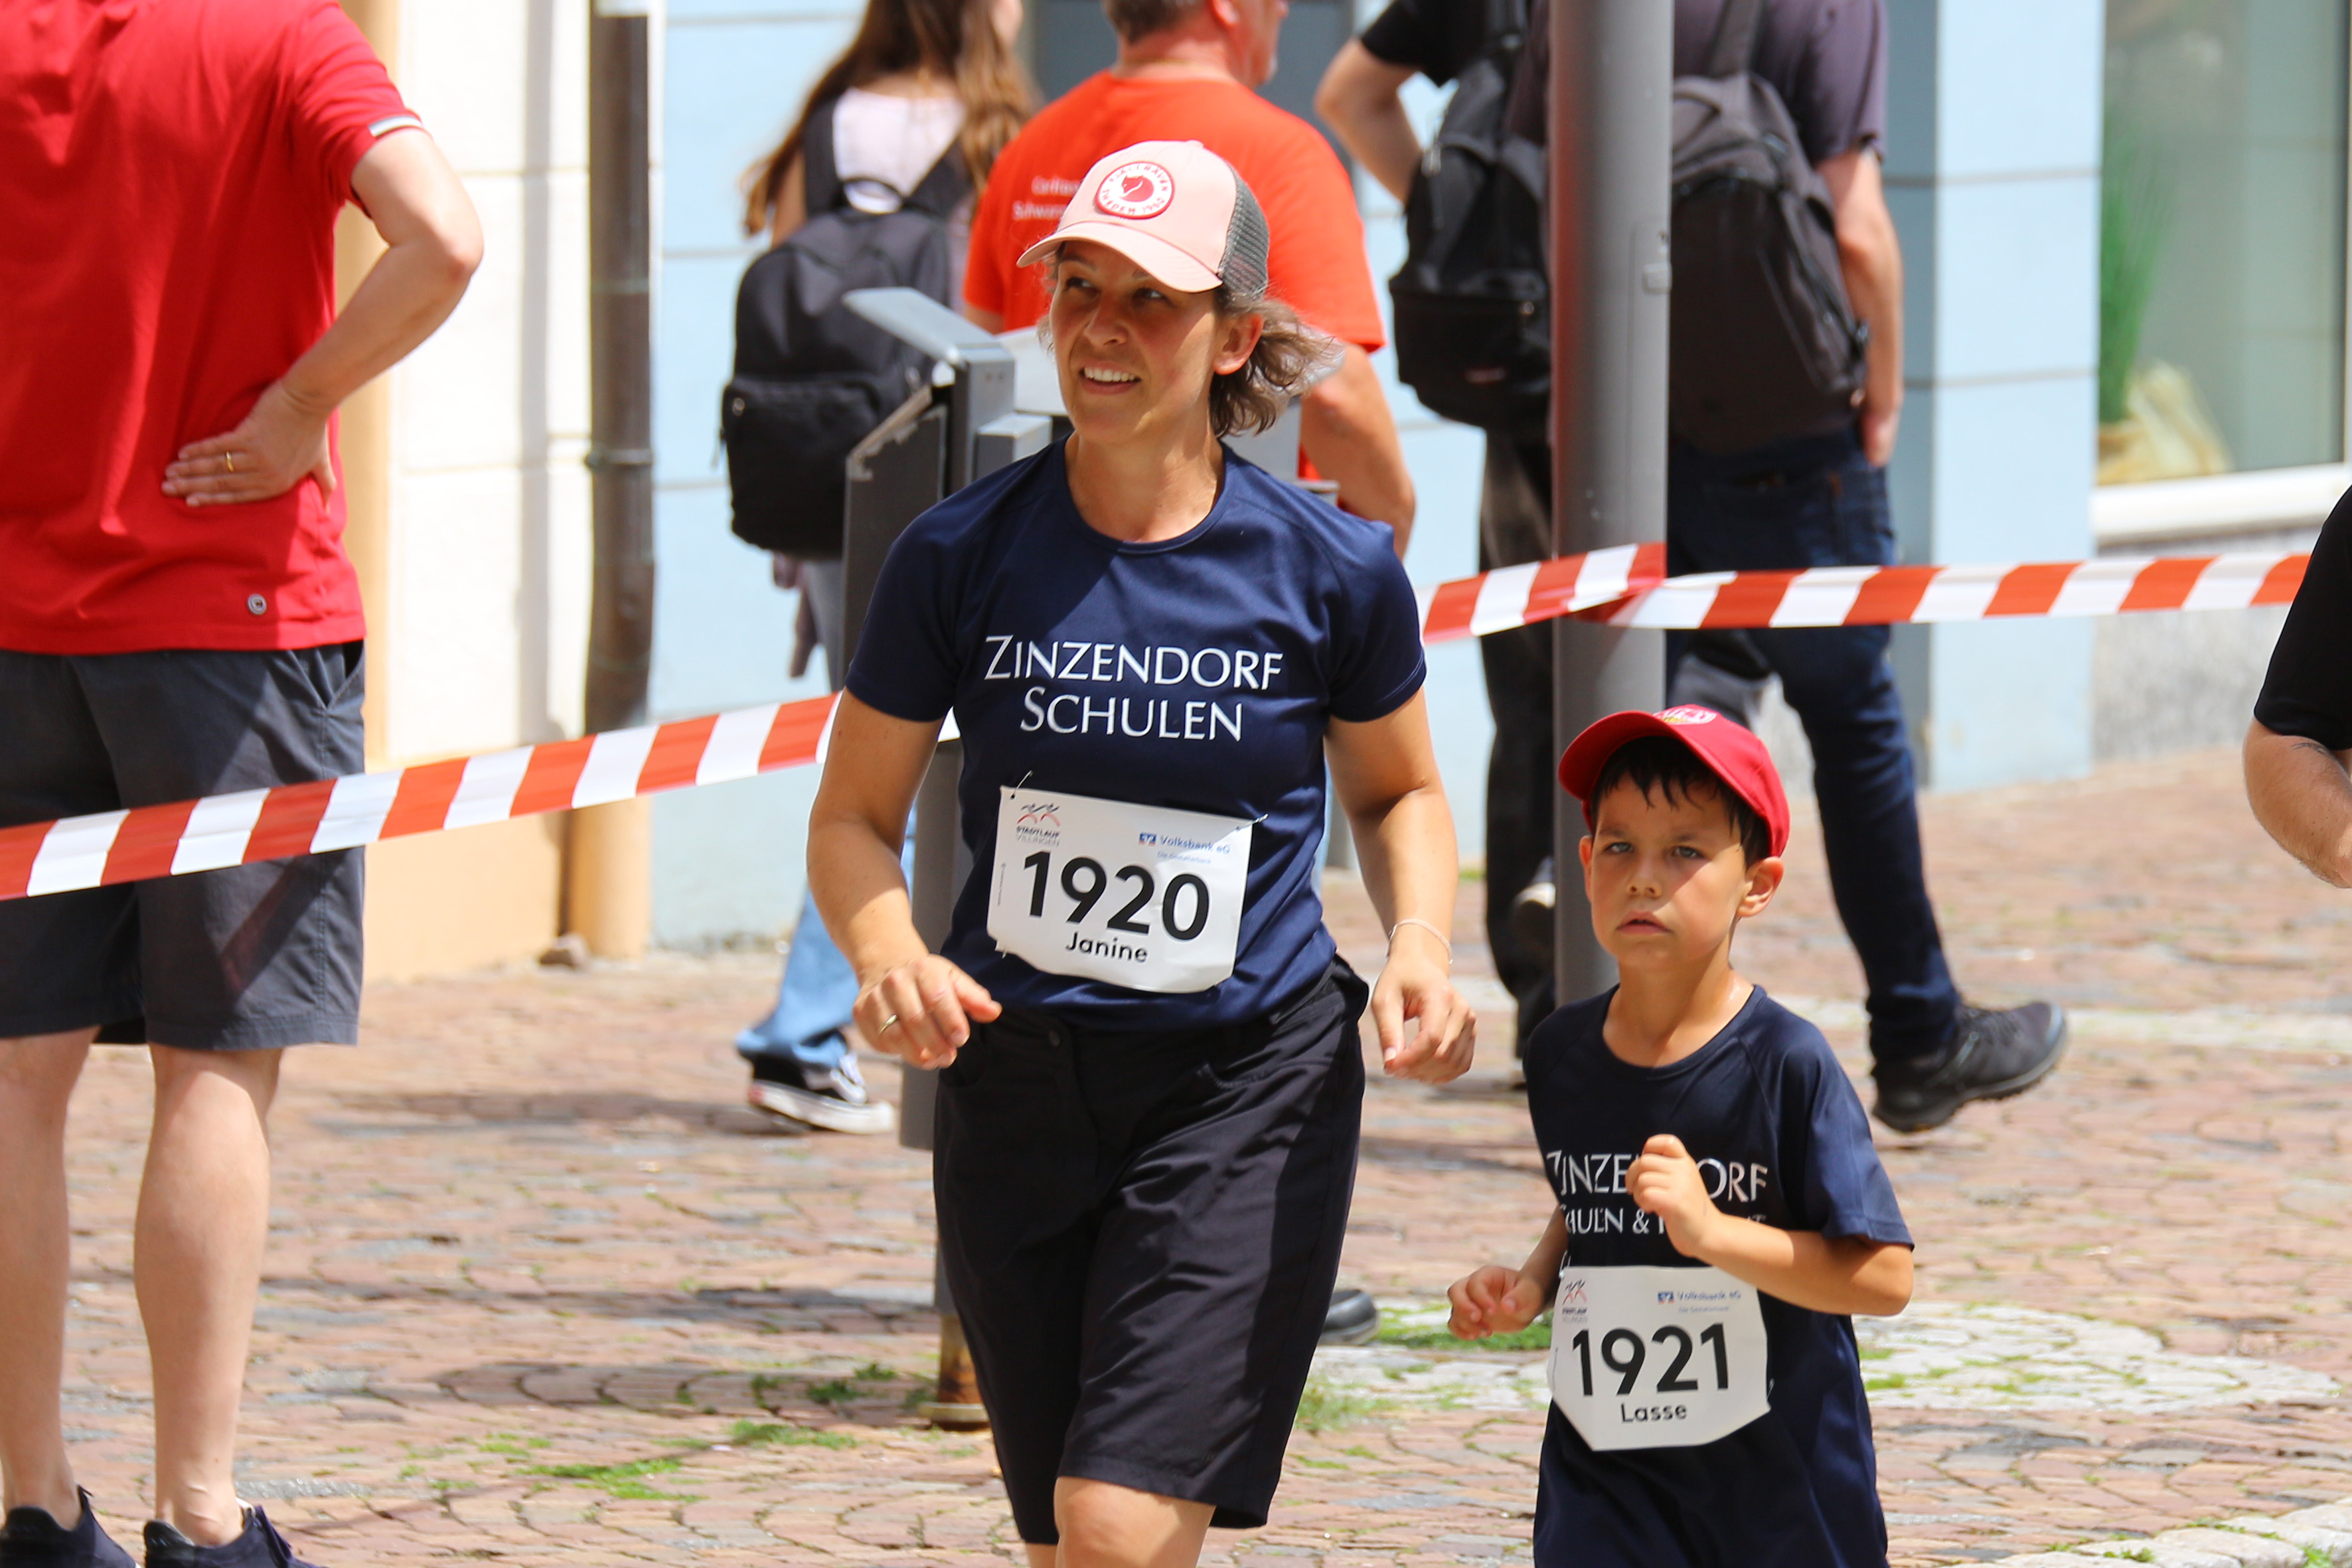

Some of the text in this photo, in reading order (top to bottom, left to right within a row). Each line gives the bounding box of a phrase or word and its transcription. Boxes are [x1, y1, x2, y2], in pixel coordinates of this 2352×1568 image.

[984, 635, 1284, 690] ZINZENDORF
[1020, 686, 1243, 742] SCHULEN
[1160, 834, 1214, 852] Volksbank
[1023, 850, 1210, 941] 1920
[1065, 931, 1148, 963] Janine
[1572, 1322, 1729, 1397] 1921
[1620, 1403, 1687, 1423] Lasse
